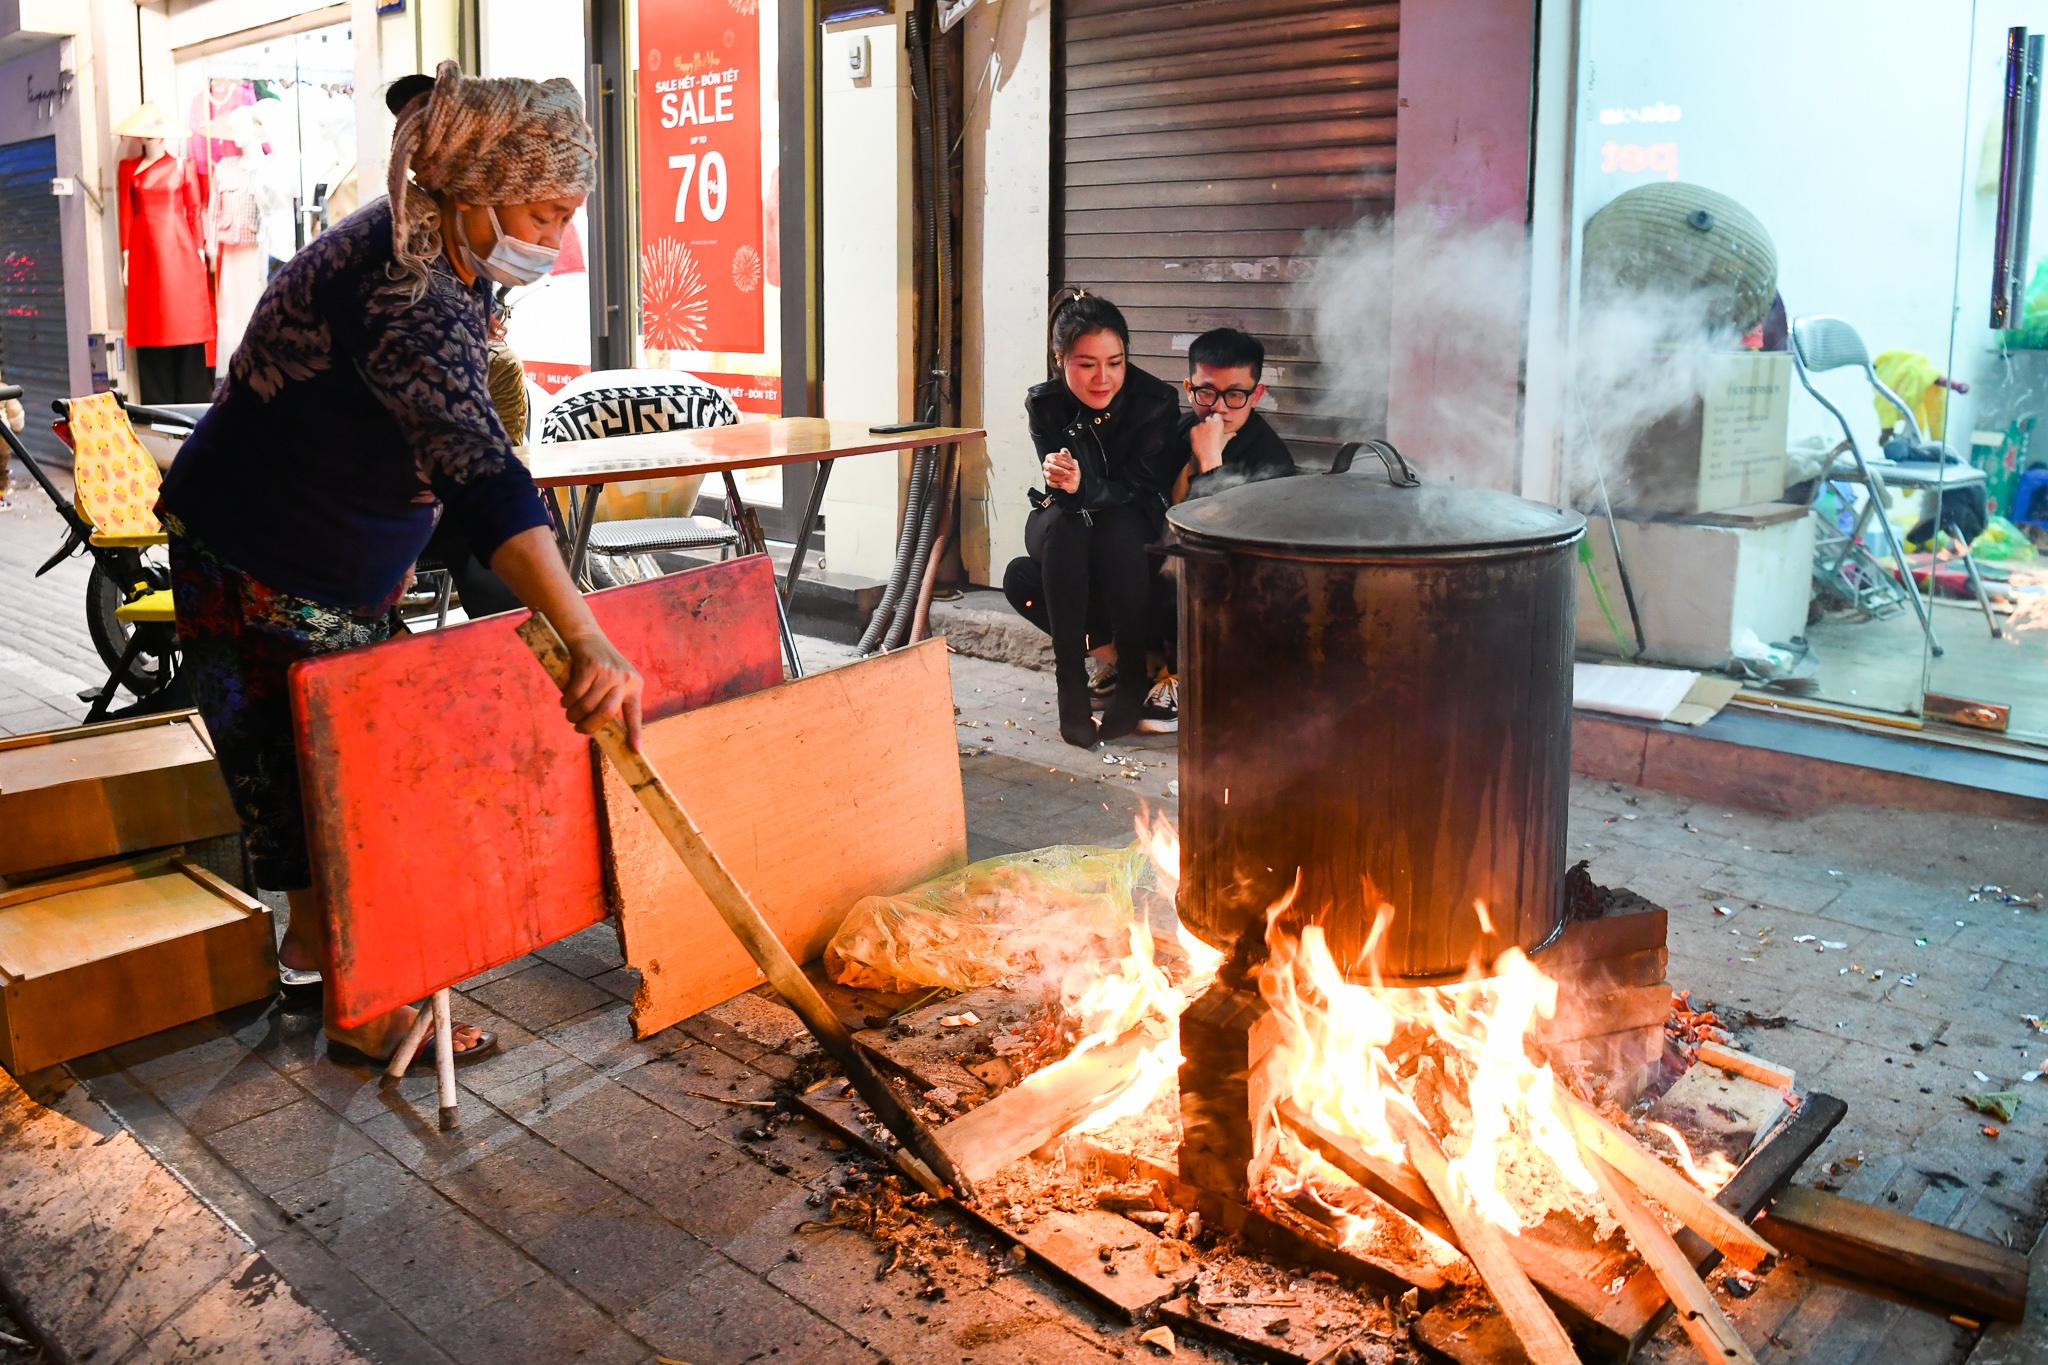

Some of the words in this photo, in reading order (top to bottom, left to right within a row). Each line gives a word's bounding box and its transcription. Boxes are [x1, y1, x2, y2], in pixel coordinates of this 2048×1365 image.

[655, 79, 678, 94] SALE
[661, 84, 734, 129] SALE
[690, 136, 699, 145] UP
[547, 373, 561, 384] SALE
